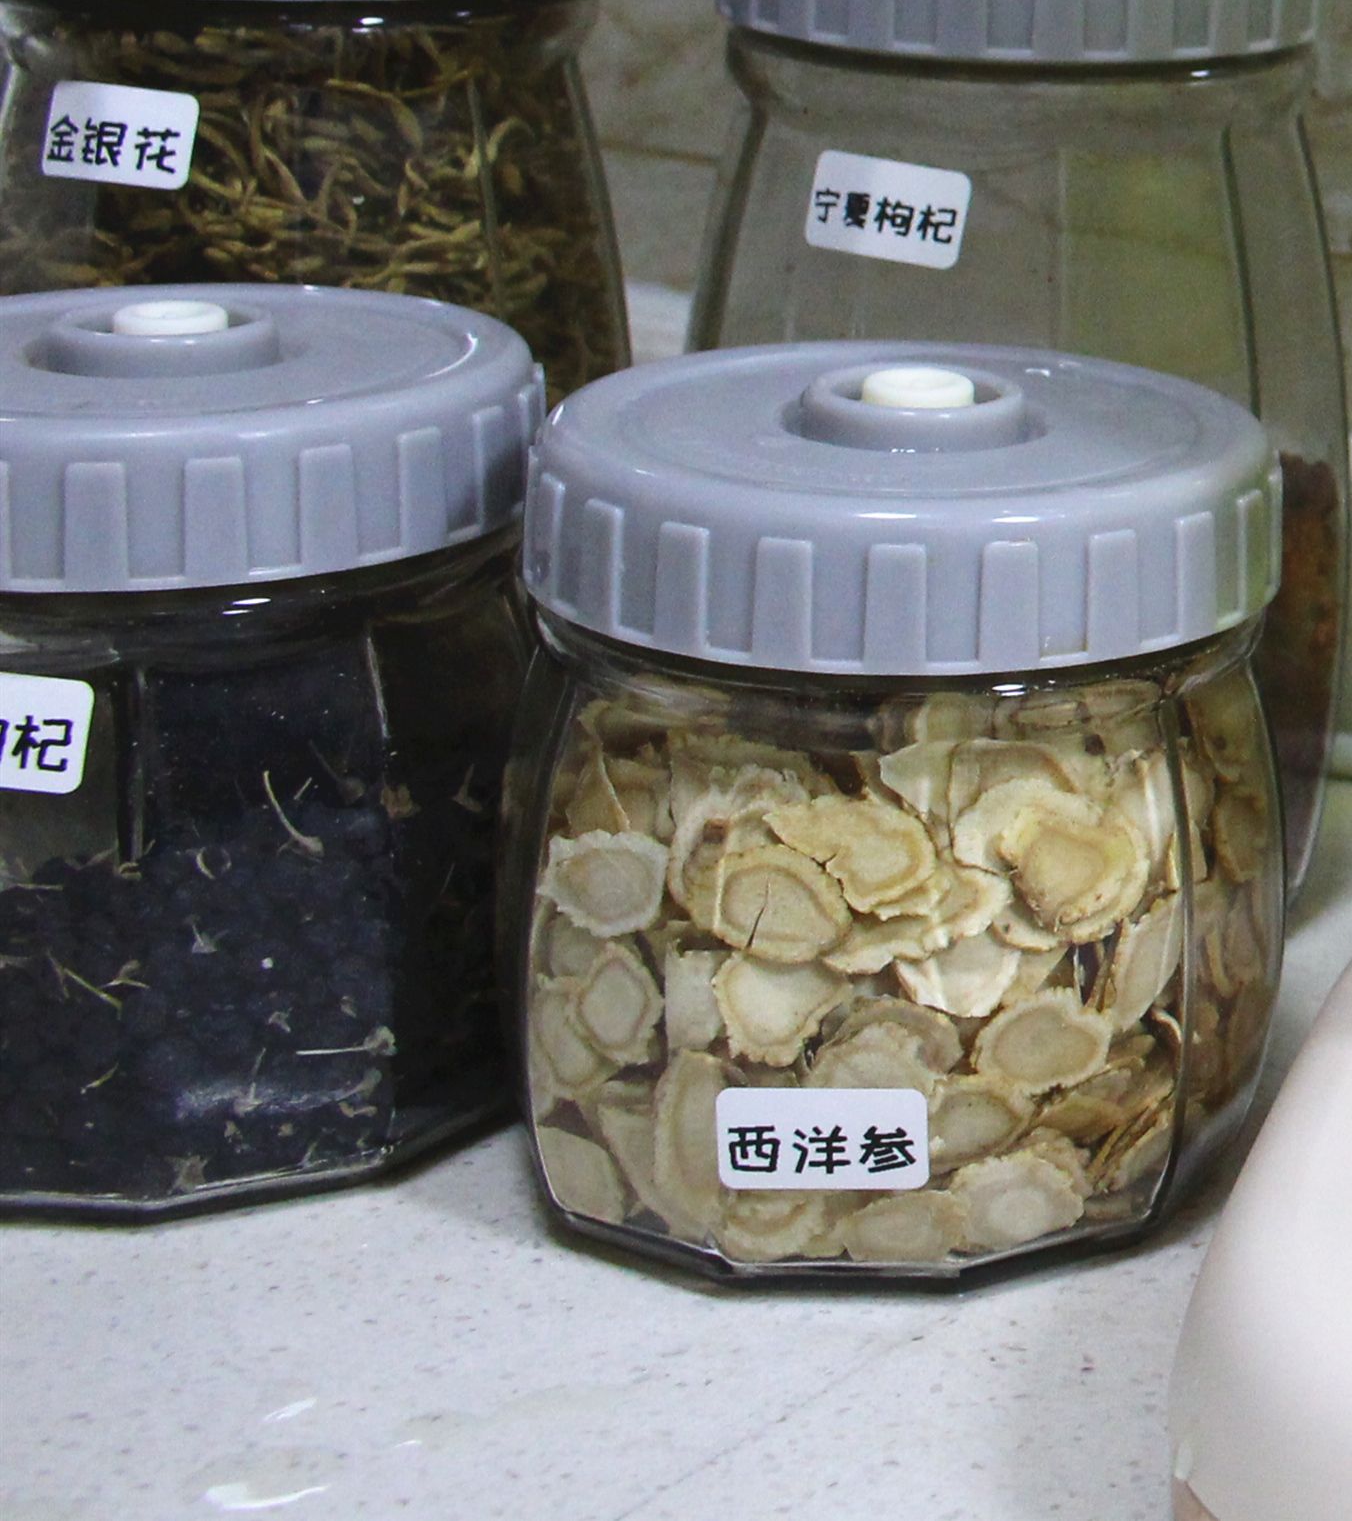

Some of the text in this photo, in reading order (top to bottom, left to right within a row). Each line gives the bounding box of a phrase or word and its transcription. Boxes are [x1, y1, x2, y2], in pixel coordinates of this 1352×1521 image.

[47, 114, 181, 174] 金银花
[815, 187, 957, 244] 宁夏枸杞
[0, 715, 73, 772] 杞
[728, 1125, 917, 1175] 西洋参
